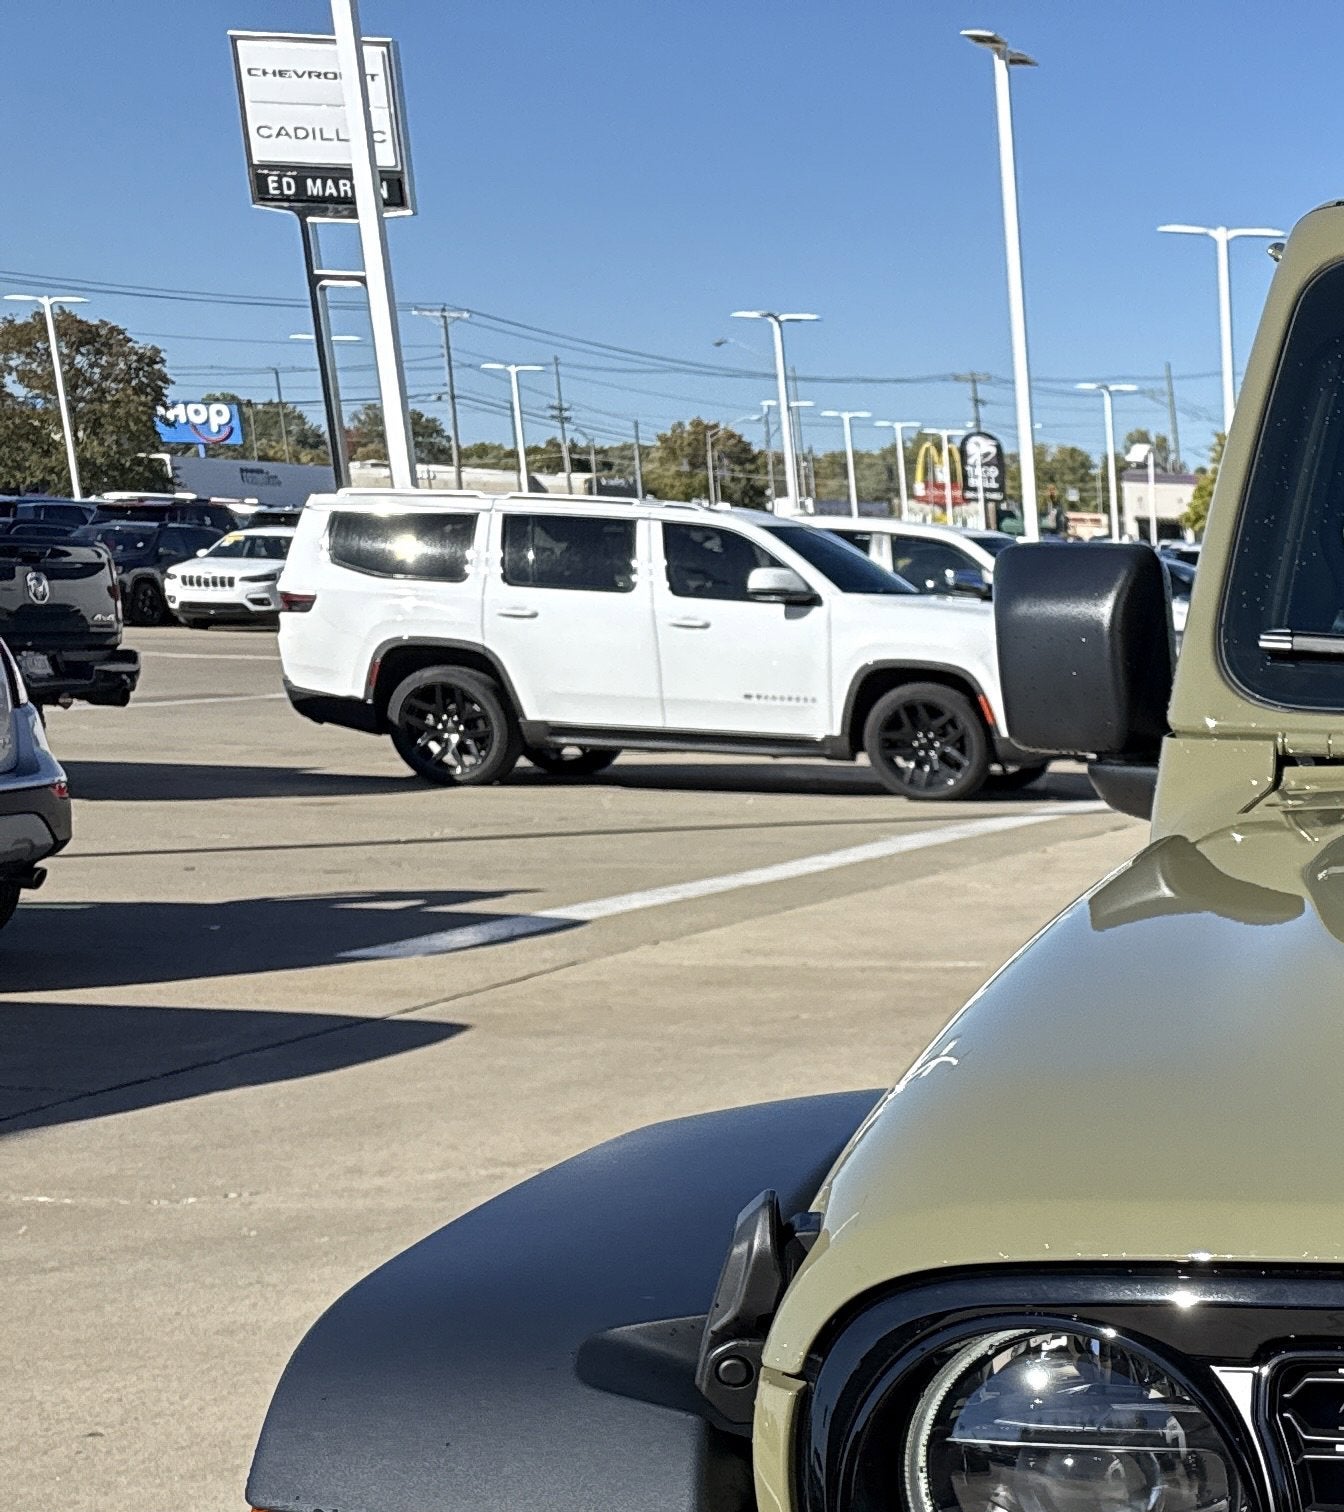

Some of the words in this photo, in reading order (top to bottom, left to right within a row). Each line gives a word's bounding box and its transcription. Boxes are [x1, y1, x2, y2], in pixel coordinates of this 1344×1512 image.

[247, 67, 380, 82] CHEVROT
[256, 125, 387, 144] CADILLC
[267, 175, 296, 195] ED
[306, 177, 388, 200] MARN
